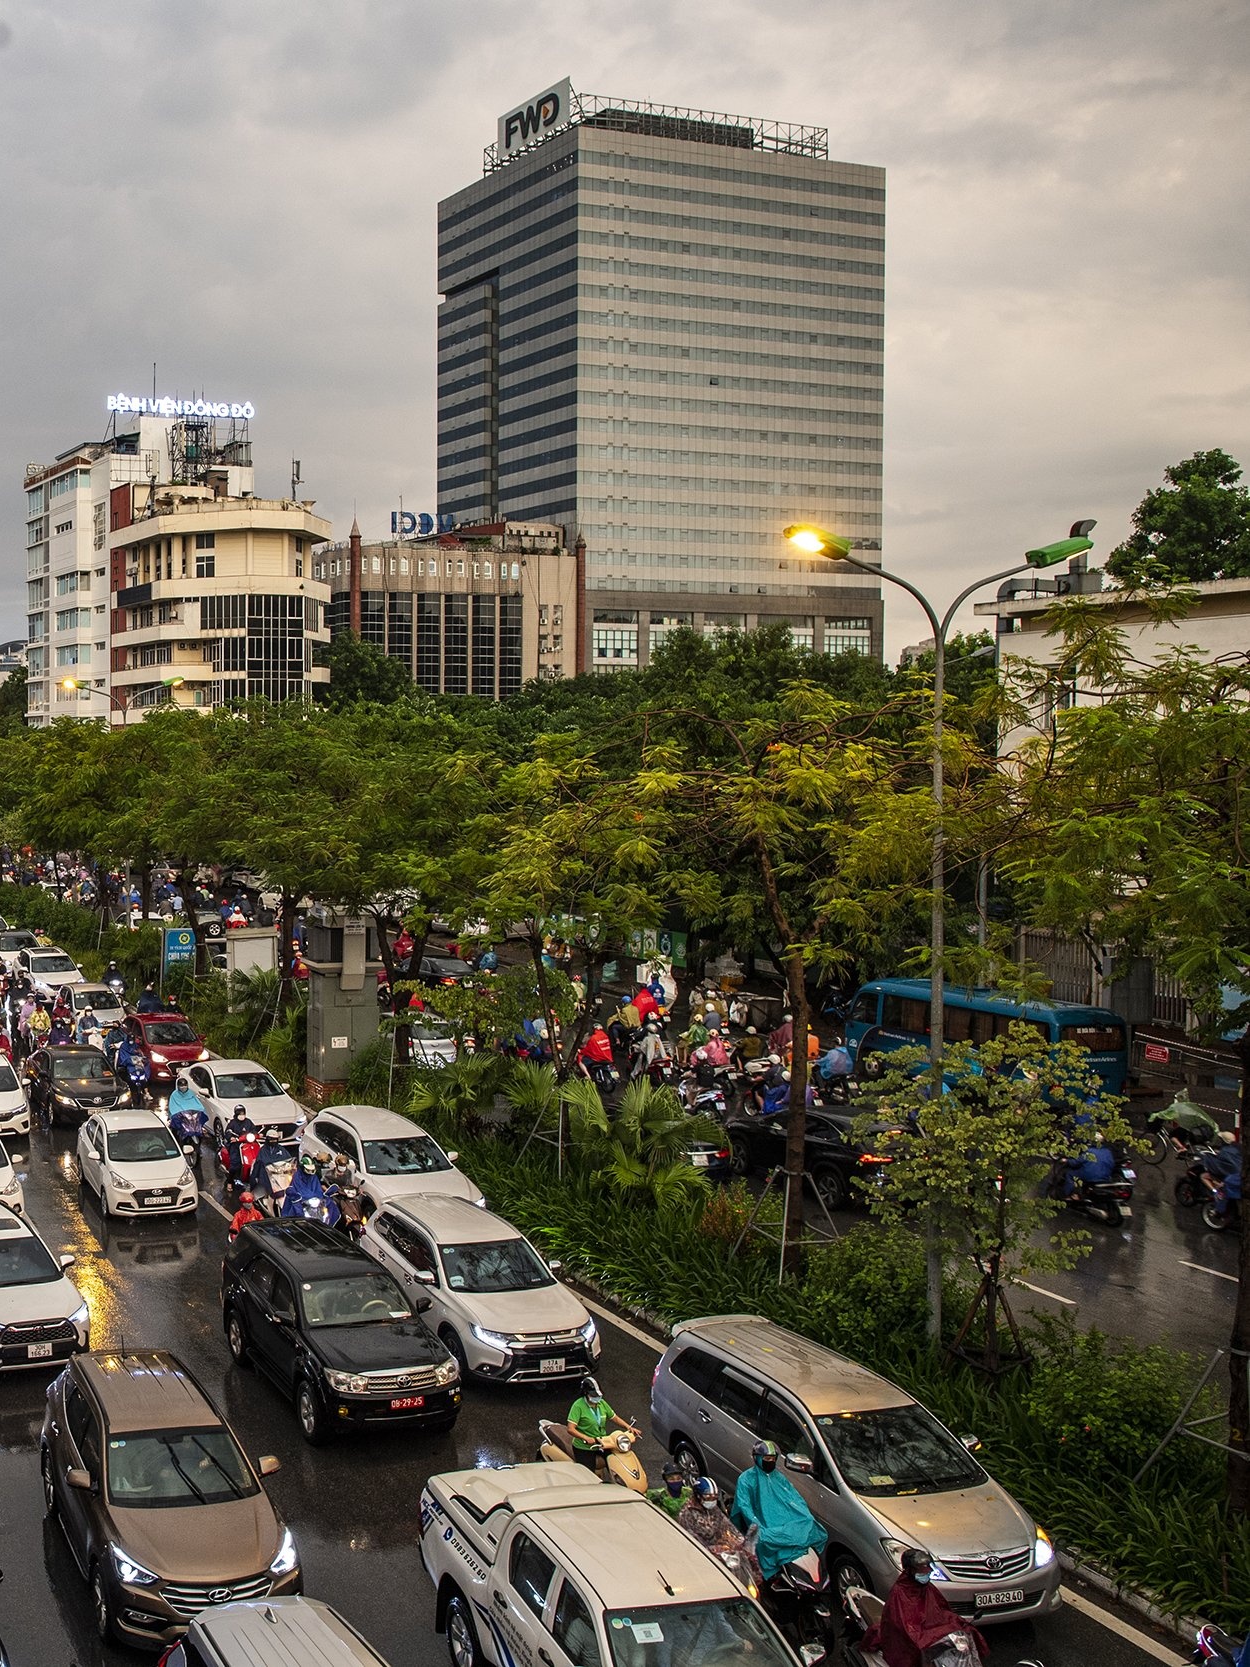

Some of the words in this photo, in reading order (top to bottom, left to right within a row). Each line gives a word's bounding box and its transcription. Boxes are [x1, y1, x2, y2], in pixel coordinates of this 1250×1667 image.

[505, 92, 560, 149] FWD
[107, 393, 147, 414] BỆNH
[977, 1590, 1023, 1606] 30A-829.40
